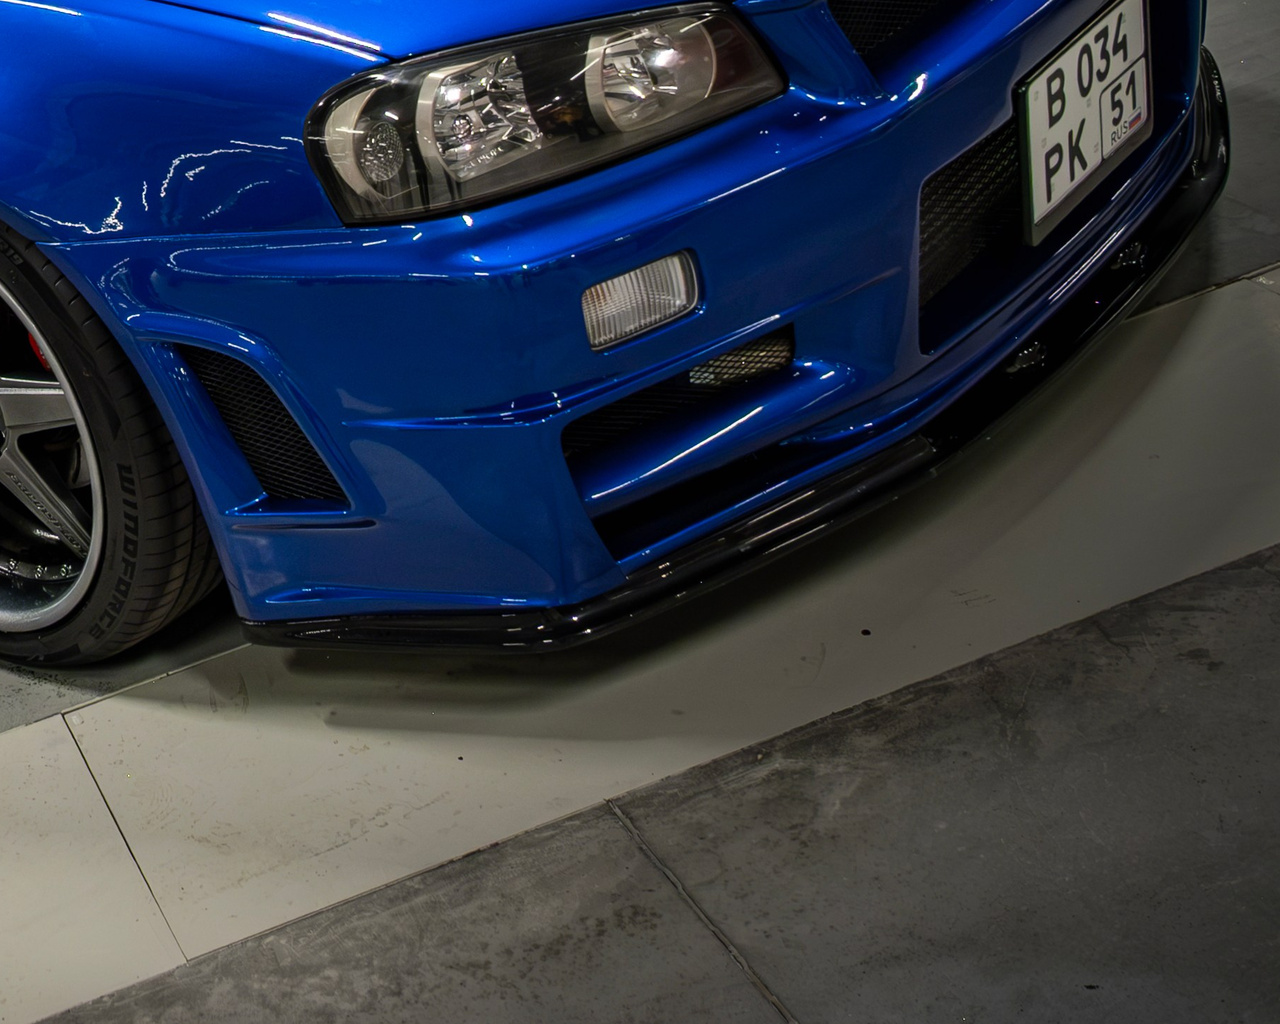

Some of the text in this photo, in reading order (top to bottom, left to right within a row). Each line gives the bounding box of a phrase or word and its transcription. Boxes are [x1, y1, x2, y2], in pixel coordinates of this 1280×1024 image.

[1076, 12, 1128, 98] 034
[1110, 70, 1137, 127] 51
[1110, 120, 1128, 147] RUS
[89, 463, 139, 640] WINDFORCE
